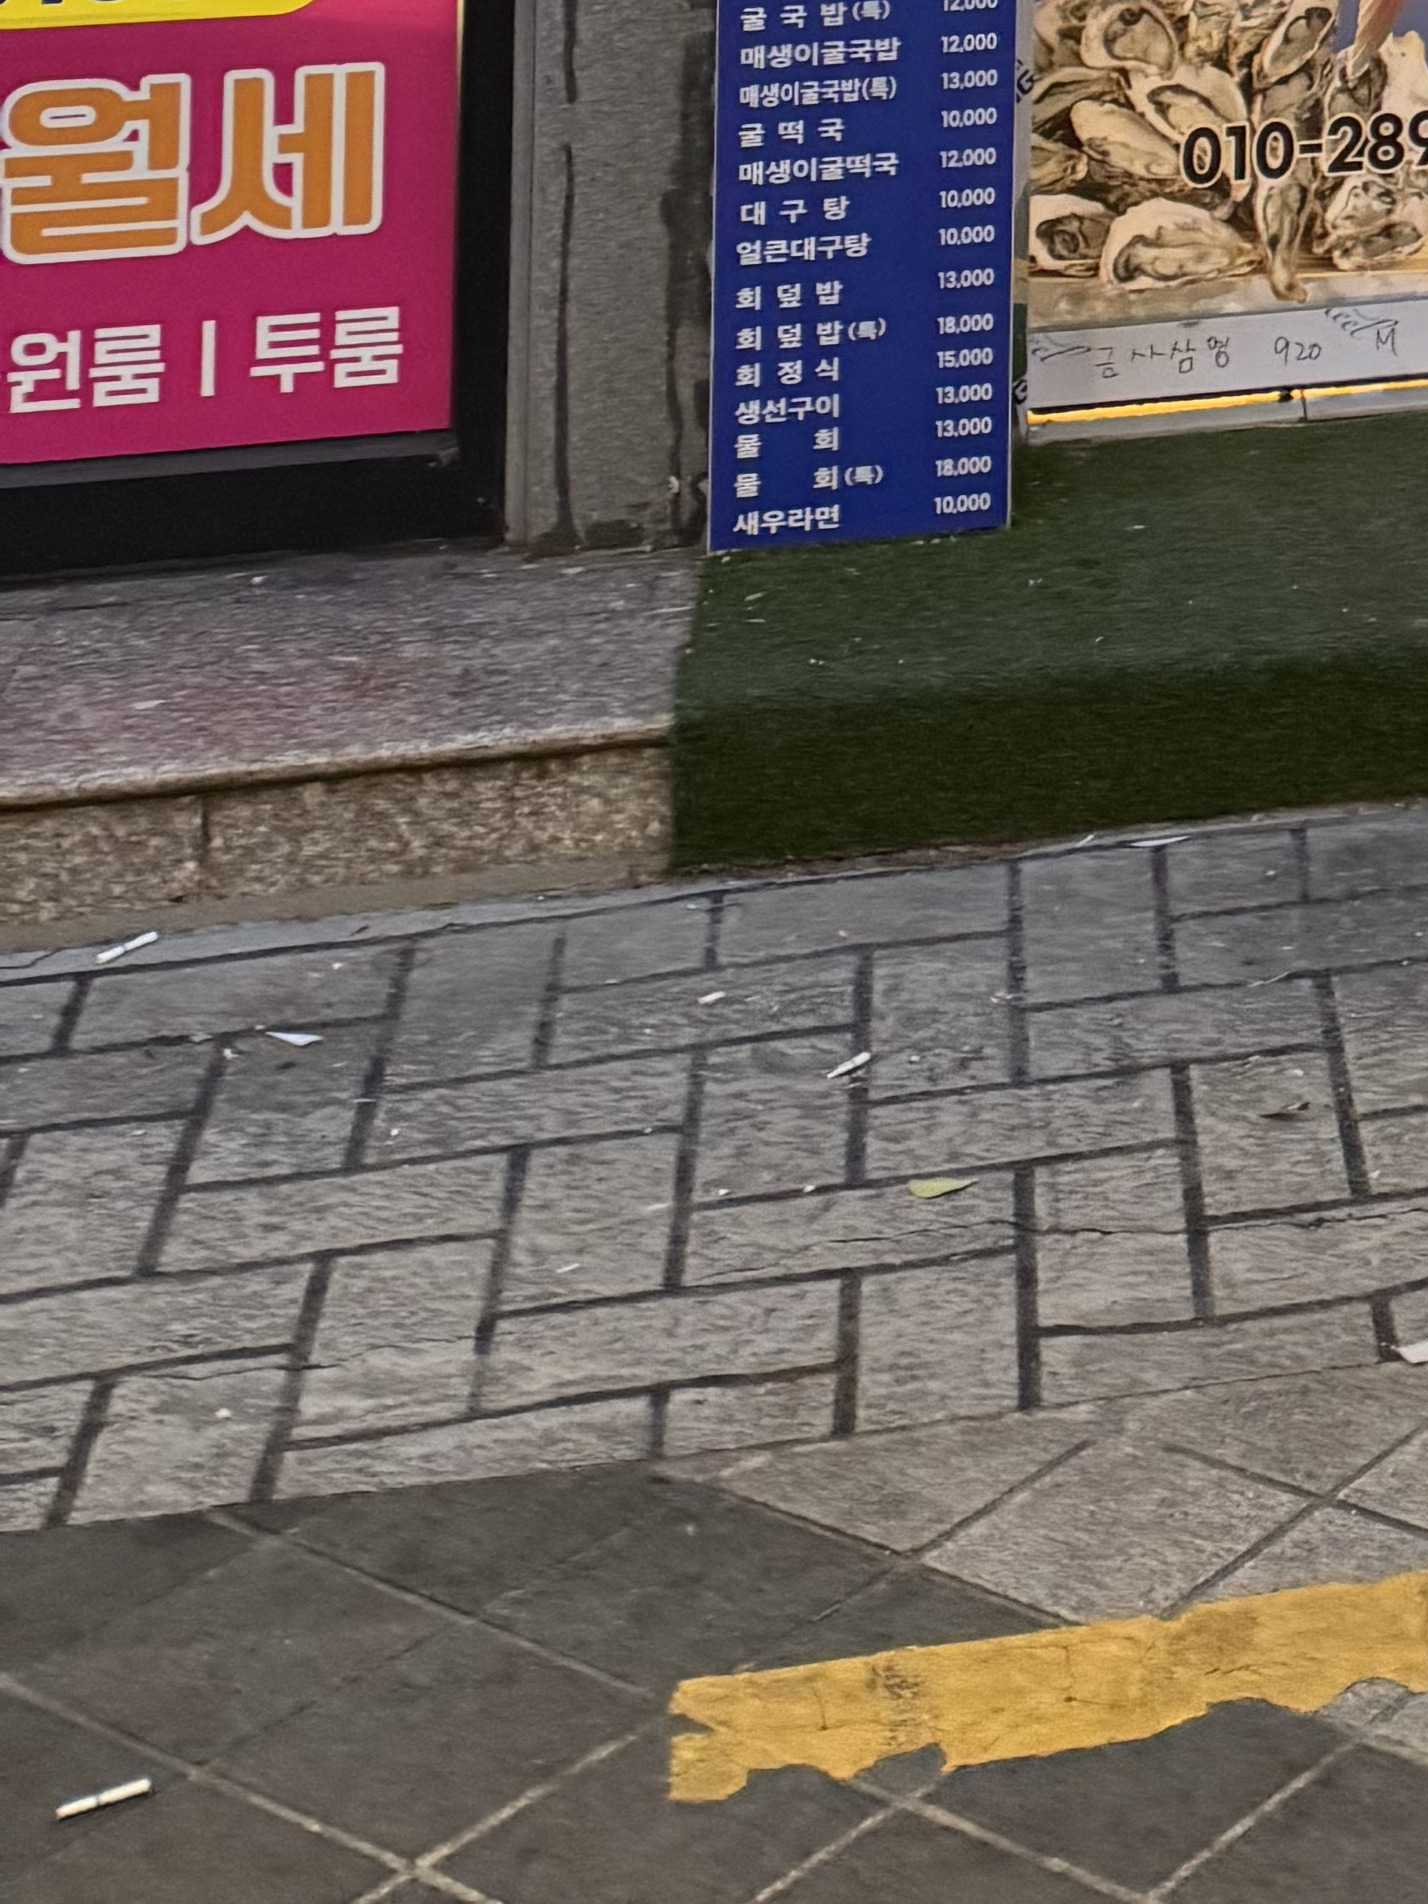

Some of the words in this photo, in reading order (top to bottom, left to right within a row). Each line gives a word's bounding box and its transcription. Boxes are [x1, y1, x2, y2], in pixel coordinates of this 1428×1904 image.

[741, 37, 901, 69] 매생이굴국밥
[941, 33, 997, 52] 12,000
[942, 69, 998, 89] 13,000
[3, 61, 385, 265] 월세
[739, 153, 899, 185] 매생이굴떡국
[940, 147, 996, 167] 12,000
[737, 233, 871, 265] 얼큰대구탕
[939, 225, 995, 245] 10,000
[938, 268, 994, 288] 13,000
[7, 322, 165, 414] 원룸
[249, 304, 404, 394] 투룸
[937, 347, 993, 368] 15,000
[735, 394, 839, 424] 생선구이
[936, 456, 992, 476] 18,000
[733, 505, 839, 535] 새우라면
[935, 493, 991, 514] 10,000
